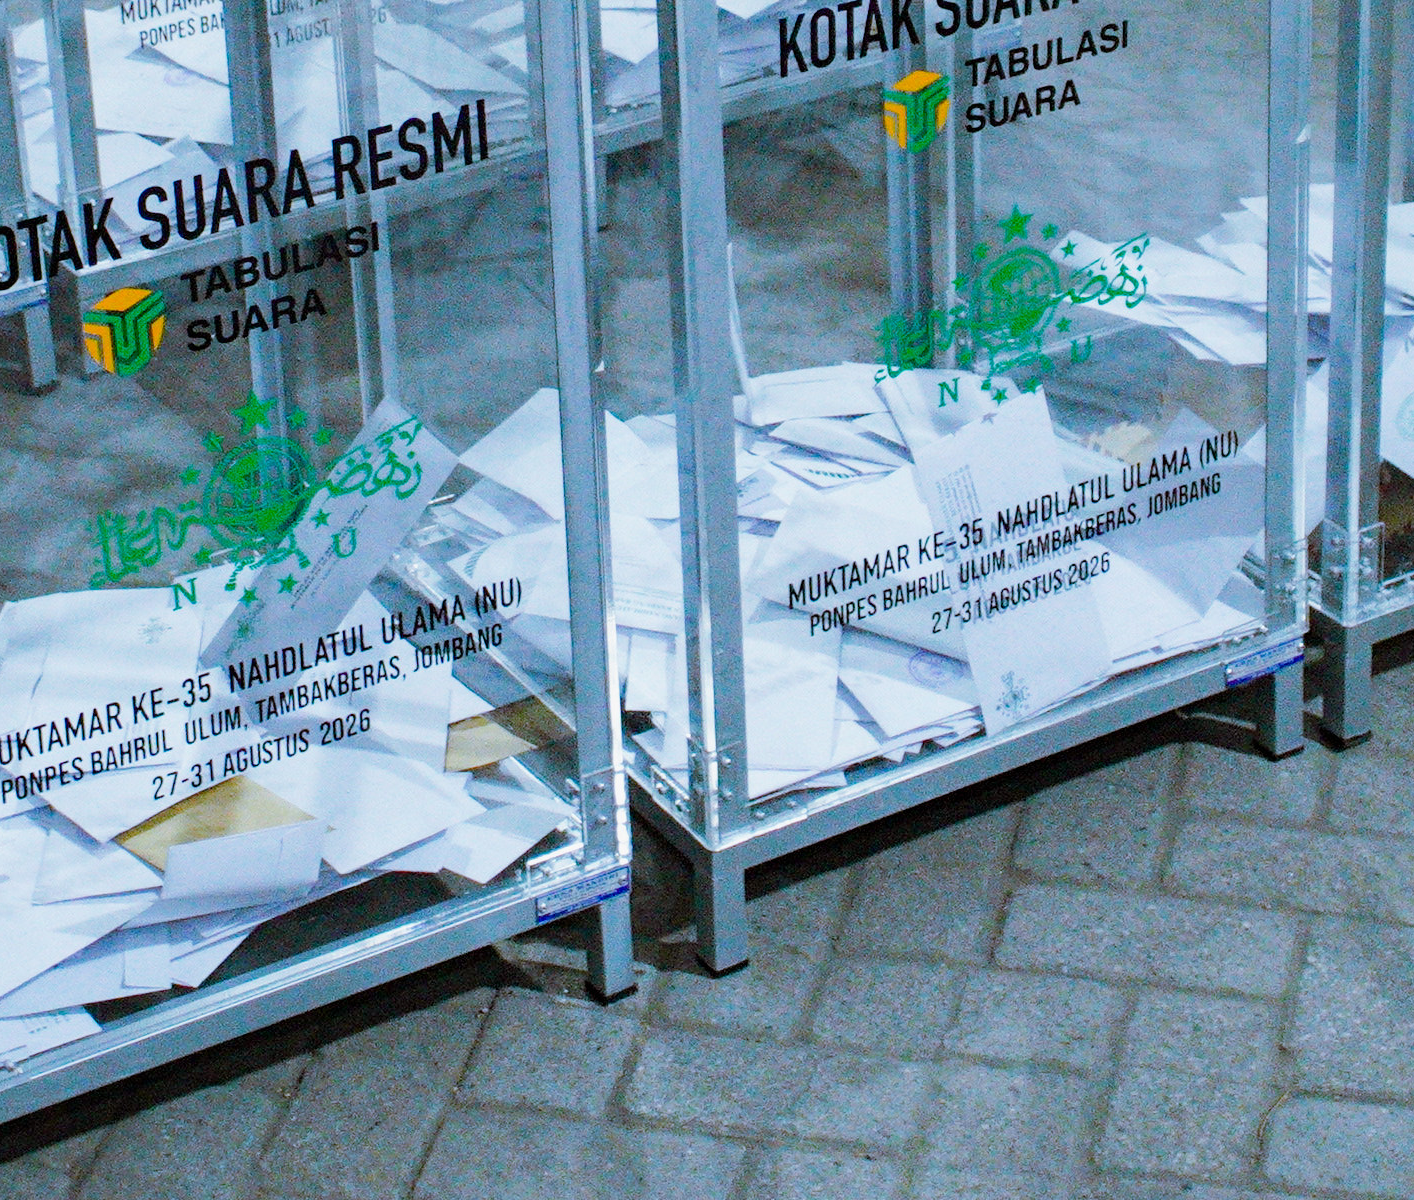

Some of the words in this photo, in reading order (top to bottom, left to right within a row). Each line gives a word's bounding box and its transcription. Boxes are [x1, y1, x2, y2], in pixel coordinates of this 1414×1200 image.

[140, 17, 196, 49] PONPES
[964, 20, 1129, 88] TABULASI
[965, 79, 1081, 134] SUARA
[138, 148, 316, 251] SUARA
[332, 98, 491, 201] RESMI
[180, 221, 380, 303] TABULASI
[186, 287, 327, 352] SUARA
[938, 378, 960, 408] N
[787, 544, 911, 611] MUKTAMAR
[917, 517, 985, 568] KE-35
[996, 474, 1116, 536] NAHDLATUL
[1122, 447, 1193, 494] ULAMA
[1198, 429, 1240, 469] (NU)
[809, 593, 877, 638] PONPES
[883, 571, 951, 613] BAHRUL
[958, 552, 1014, 590] ULUM,
[1017, 504, 1142, 564] TAMBAKBERAS,
[1146, 472, 1222, 521] JOMBANG
[172, 577, 198, 612] N
[331, 529, 358, 560] U
[931, 597, 984, 635] 27-31
[988, 568, 1064, 616] AGUSTUS
[1068, 551, 1111, 587] 2026
[131, 672, 213, 725] KE-35
[228, 623, 373, 693] NAHDLATUL
[381, 594, 467, 646] ULAMA
[474, 576, 523, 621] (NU)
[0, 755, 84, 805] PONPES
[90, 729, 174, 776] BAHRUL
[184, 706, 249, 746] ULUM,
[255, 656, 407, 720] TAMBAKBERAS,
[411, 623, 504, 675] JOMBANG
[151, 760, 216, 802] 27-31
[221, 728, 311, 778] AGUSTUS
[319, 708, 372, 747] 2026
